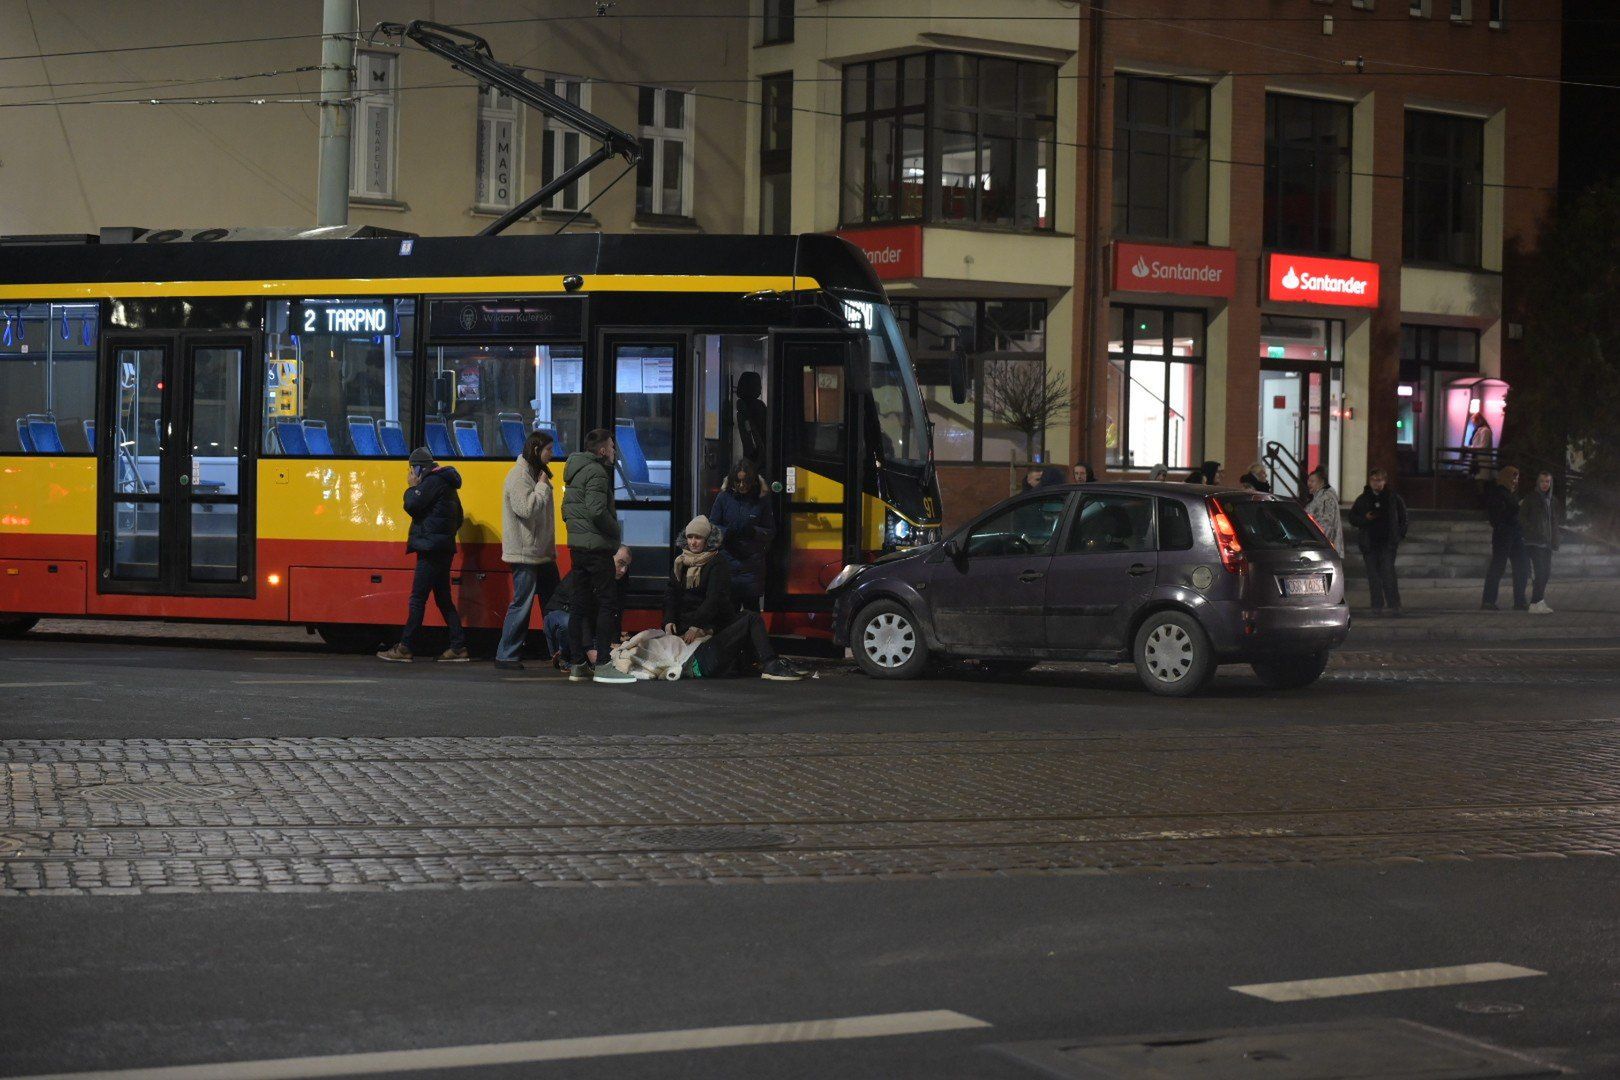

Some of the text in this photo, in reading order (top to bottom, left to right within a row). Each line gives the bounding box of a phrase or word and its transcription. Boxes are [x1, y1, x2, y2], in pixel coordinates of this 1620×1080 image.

[498, 127, 509, 199] IMAGO
[866, 246, 902, 264] ander
[1151, 261, 1223, 282] Santander
[1300, 272, 1367, 294] Santander
[304, 308, 386, 331] 2 TARPNO
[483, 313, 514, 323] Wiktor
